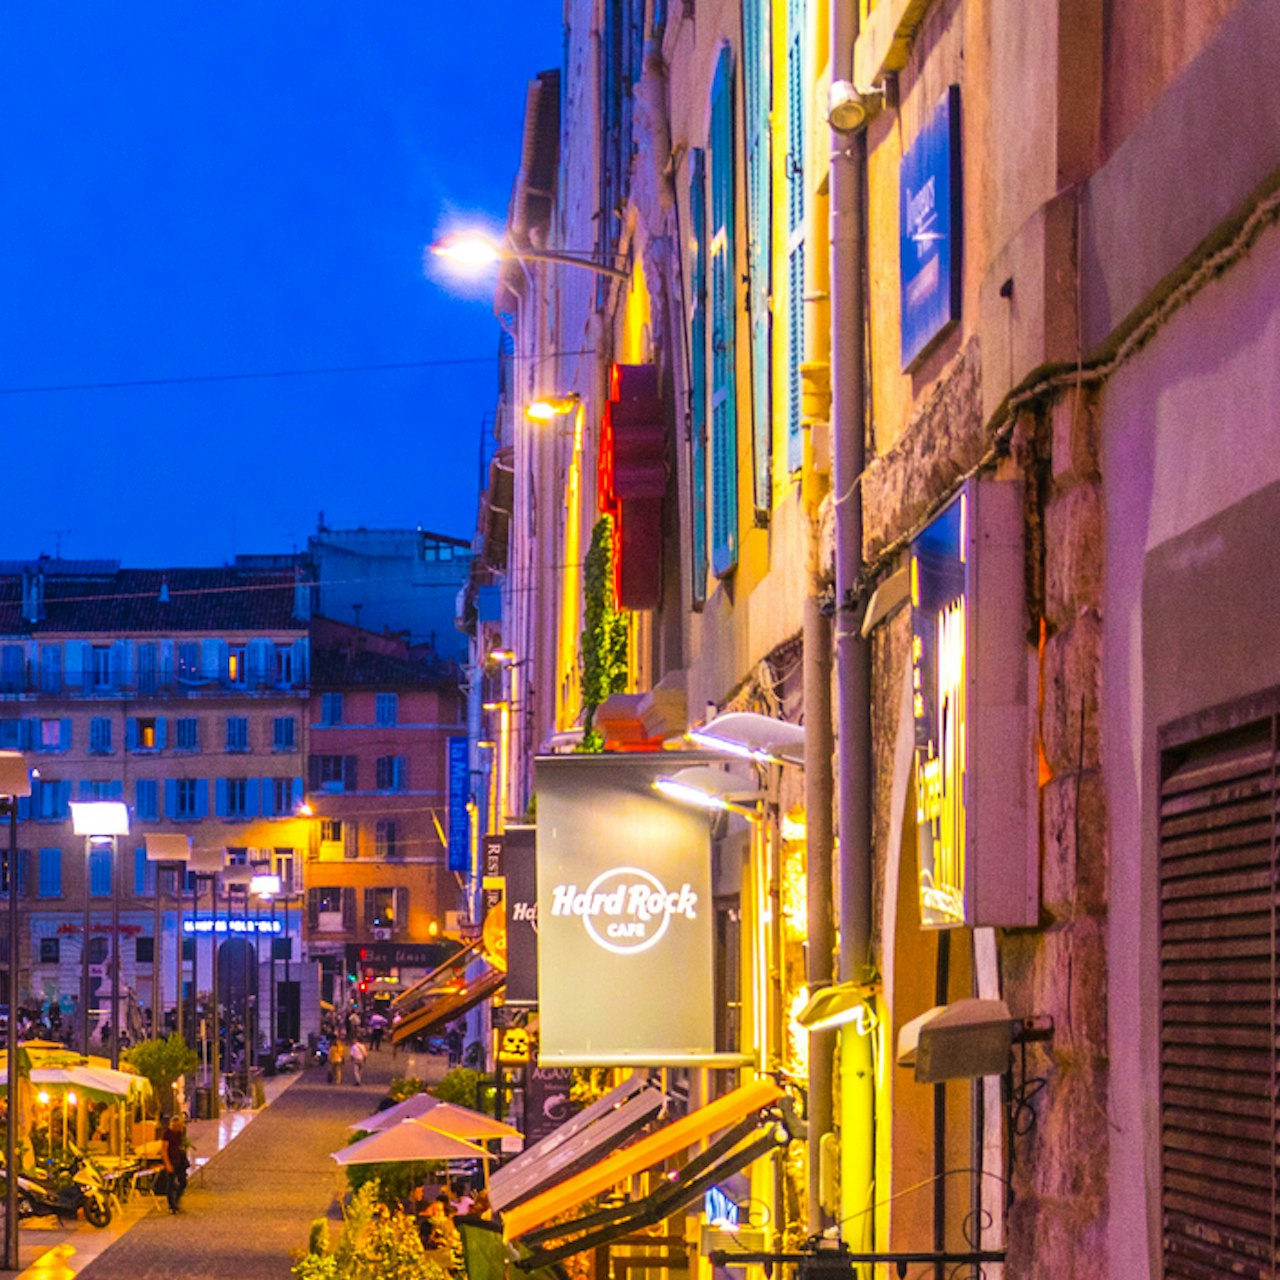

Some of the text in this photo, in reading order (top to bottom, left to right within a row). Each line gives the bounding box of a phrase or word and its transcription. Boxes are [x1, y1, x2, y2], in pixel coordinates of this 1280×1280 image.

[551, 883, 698, 920] Hard Rock
[513, 902, 537, 921] Ha
[606, 922, 646, 937] CAFE
